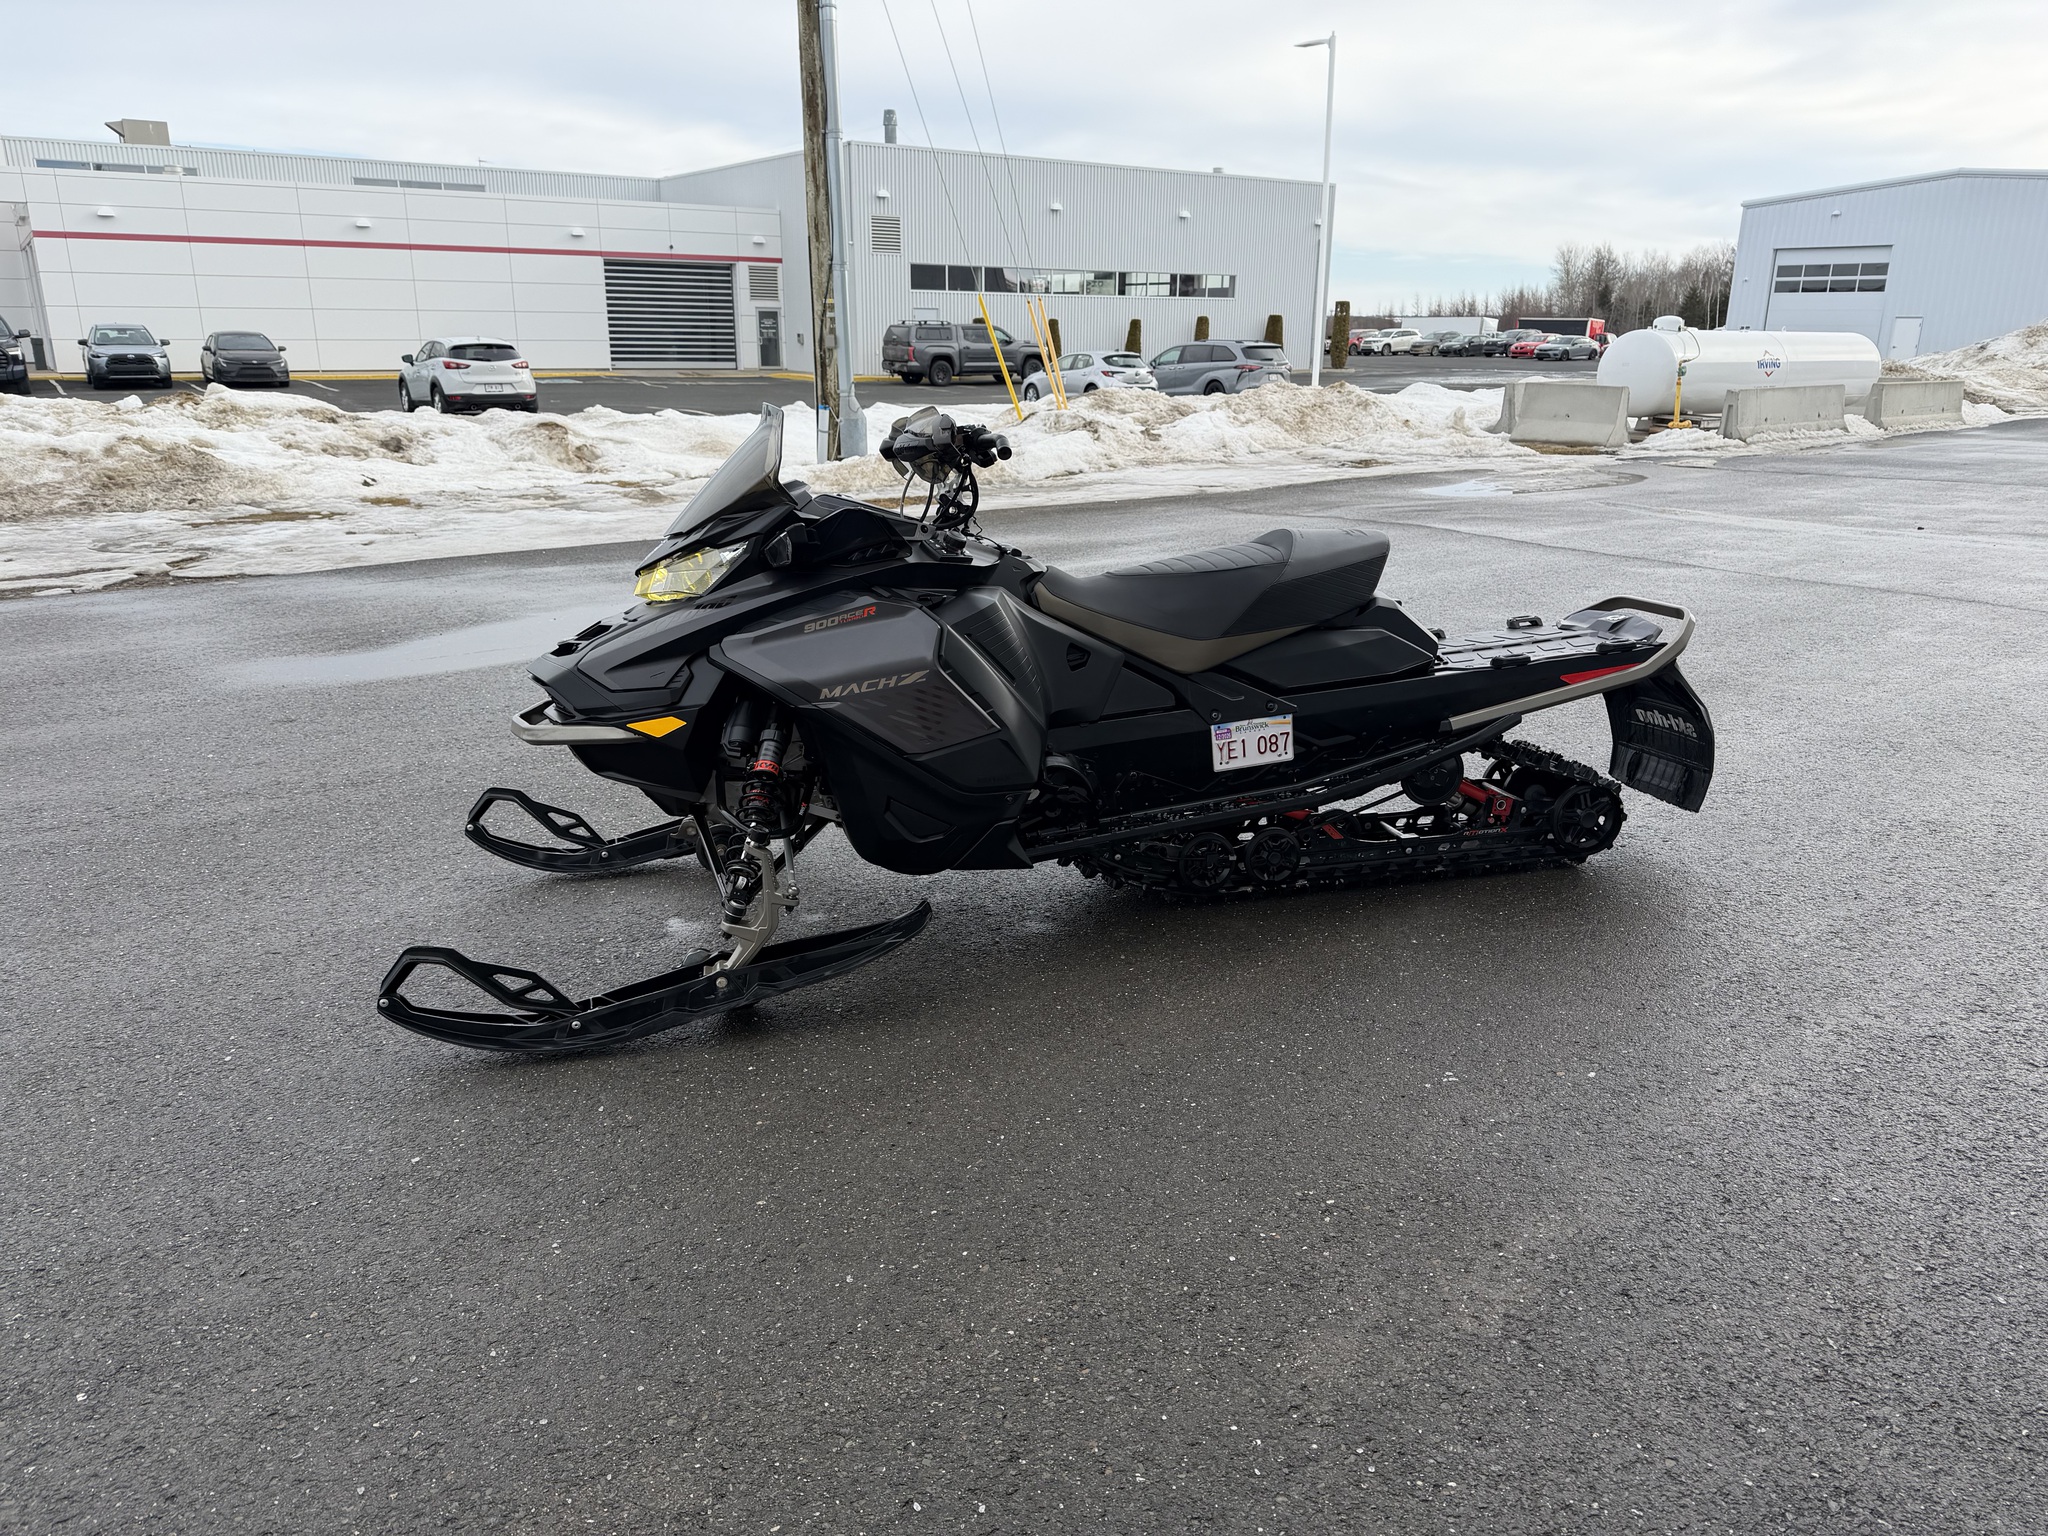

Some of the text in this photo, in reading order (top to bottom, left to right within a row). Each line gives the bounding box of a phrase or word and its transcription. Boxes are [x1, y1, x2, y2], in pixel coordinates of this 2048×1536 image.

[1756, 358, 1781, 369] IRVING
[1235, 721, 1270, 733] Brunswick
[1215, 731, 1291, 761] YE1 087
